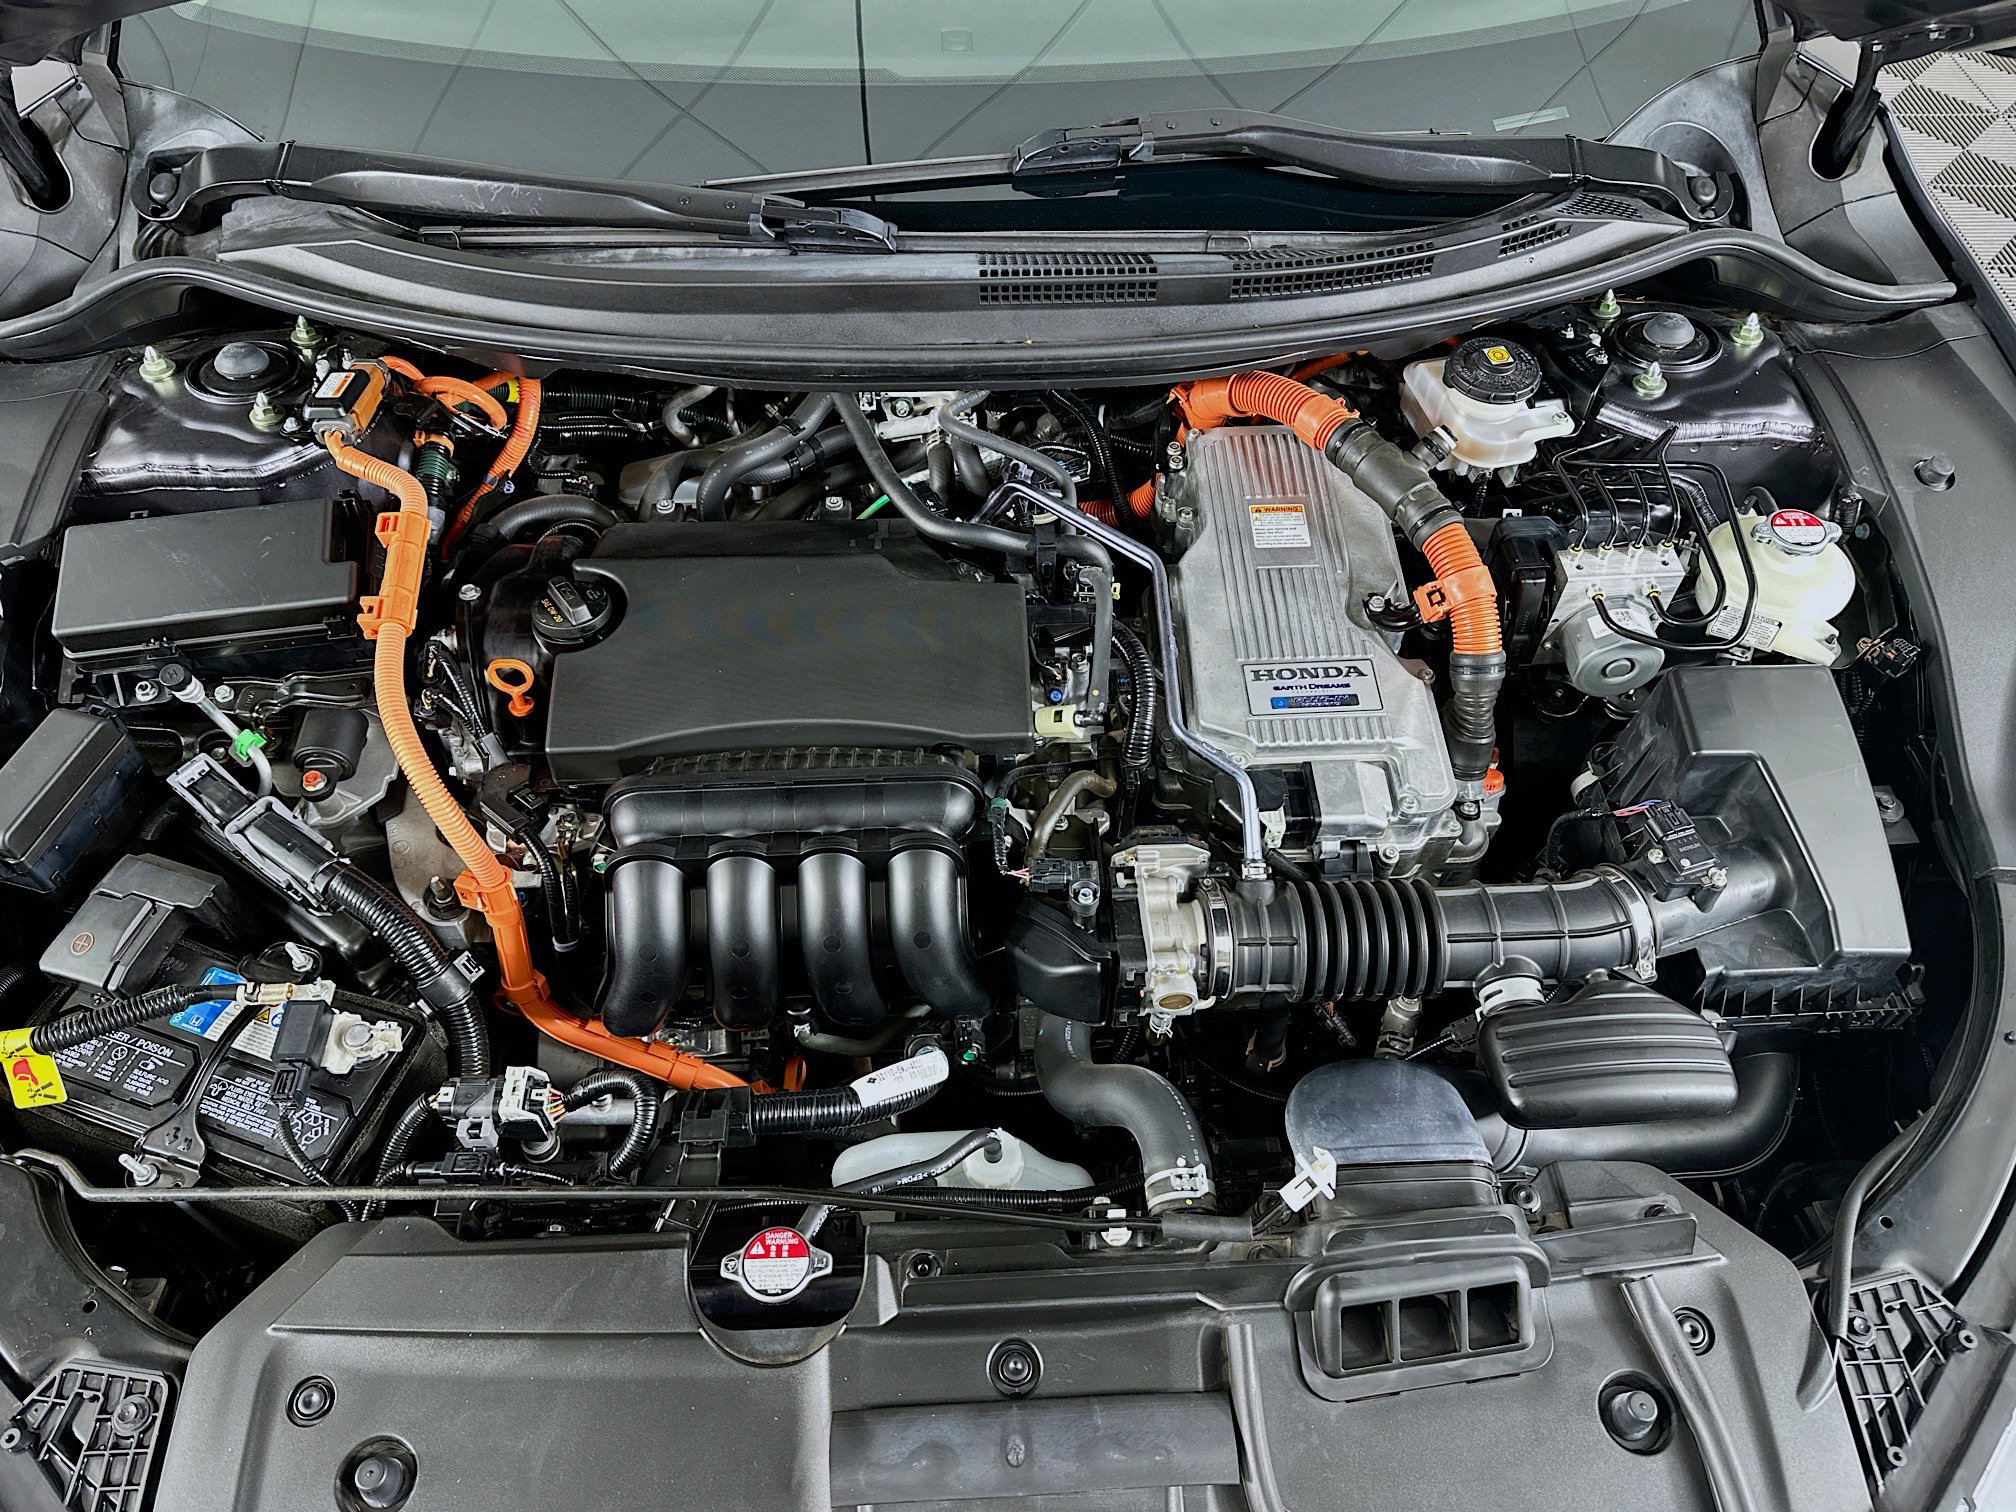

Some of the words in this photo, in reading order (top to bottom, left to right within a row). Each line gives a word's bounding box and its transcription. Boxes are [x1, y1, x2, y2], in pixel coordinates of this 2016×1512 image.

[1250, 665, 1369, 682] HONDA
[139, 1038, 175, 1058] POISON
[156, 1077, 170, 1086] ACID
[765, 1232, 793, 1240] DANGER
